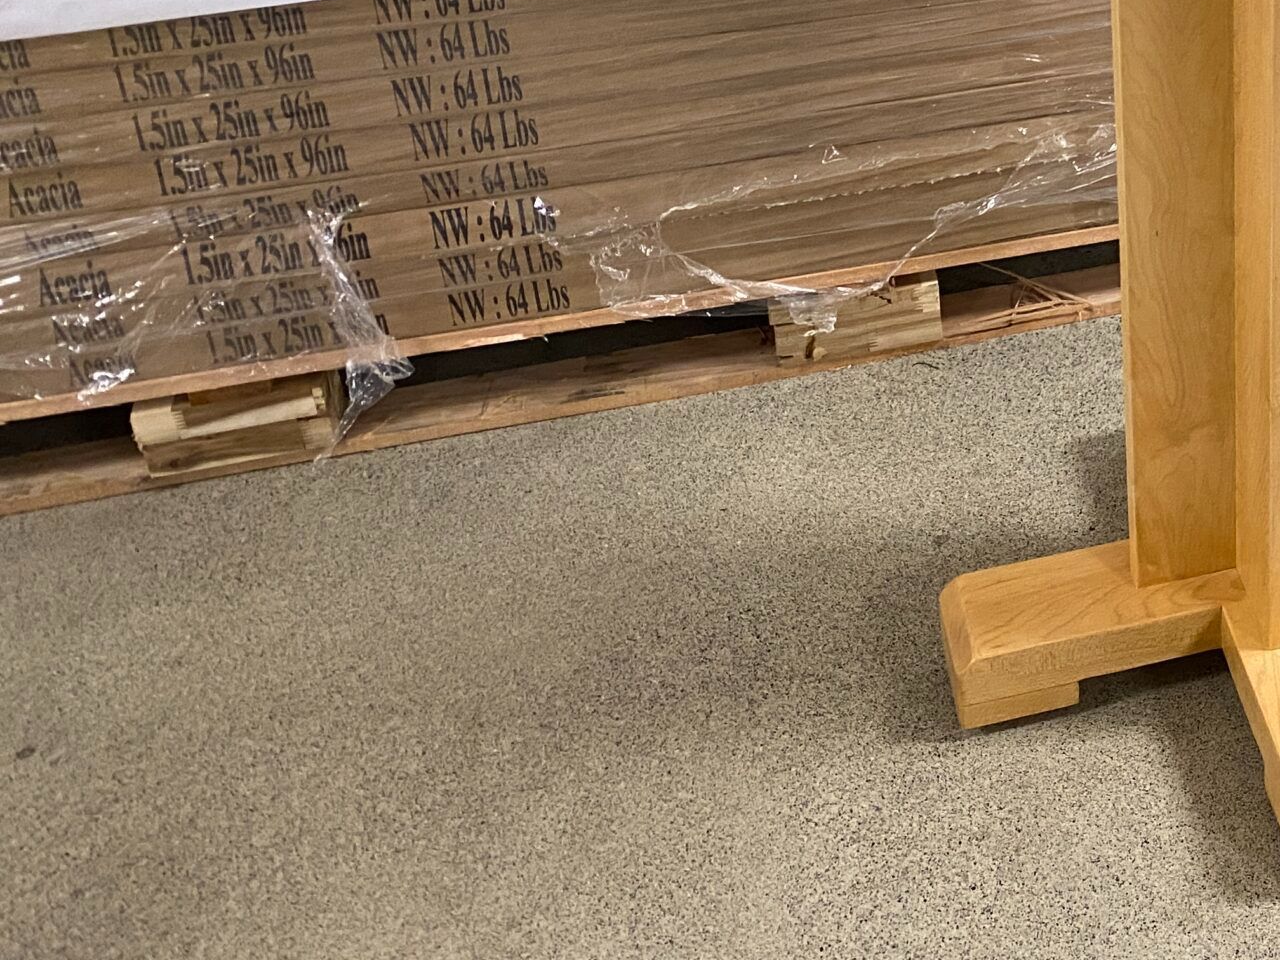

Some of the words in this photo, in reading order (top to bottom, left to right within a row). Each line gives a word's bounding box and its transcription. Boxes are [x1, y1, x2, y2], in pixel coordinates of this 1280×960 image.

[440, 23, 465, 62] 64
[469, 19, 510, 58] Lbs
[113, 61, 172, 103] 1.5in
[192, 51, 245, 92] 25in
[264, 42, 315, 84] 96in
[453, 69, 479, 109] 64
[482, 66, 523, 105] Lbs
[131, 108, 189, 152] 1.5in
[209, 99, 261, 141] 25in
[280, 91, 330, 131] 96in
[471, 113, 495, 153] 64
[499, 109, 539, 149] Lbs
[8, 171, 84, 218] Acacia
[154, 154, 208, 196] 1.5in
[230, 144, 280, 186] 25in
[300, 134, 349, 176] 96in
[39, 260, 113, 307] Acacia
[180, 243, 234, 285] 1.5in
[255, 233, 303, 274] 25in
[497, 246, 521, 279] 64
[523, 244, 563, 275] Lbs
[506, 282, 529, 317] 64
[532, 279, 570, 313] Lbs
[279, 315, 323, 354] 25in
